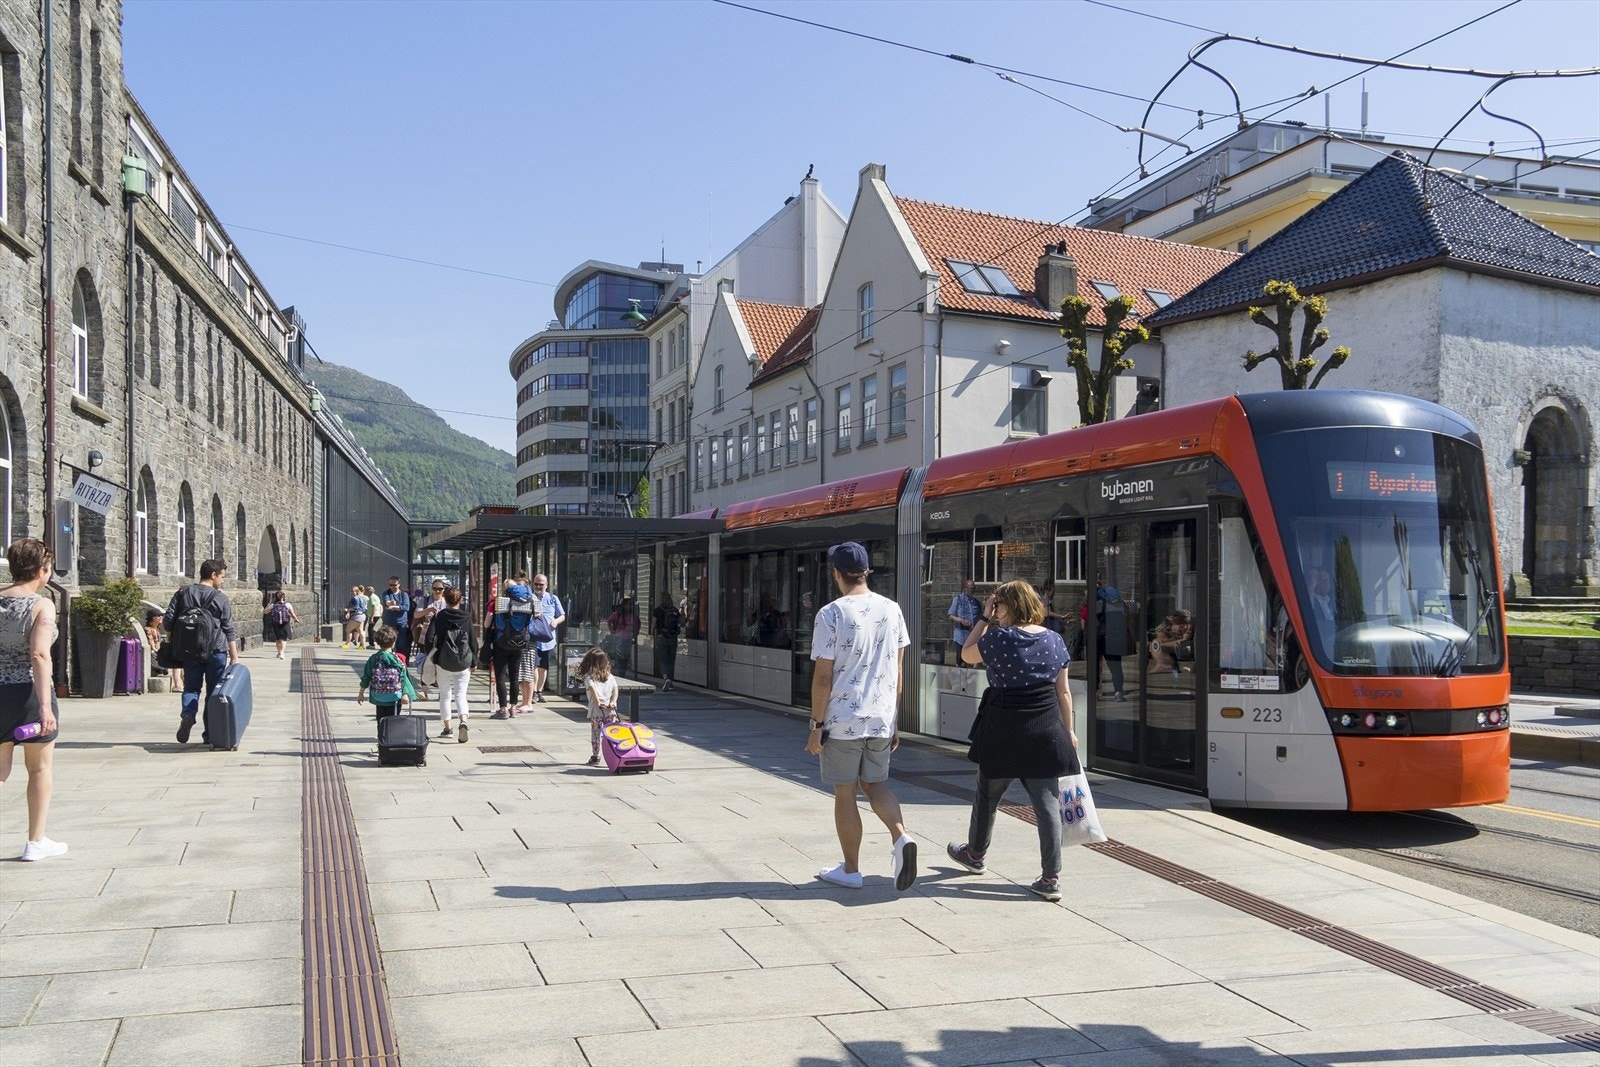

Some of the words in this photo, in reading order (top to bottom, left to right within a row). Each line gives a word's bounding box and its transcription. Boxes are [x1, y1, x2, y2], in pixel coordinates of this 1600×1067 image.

[1101, 479, 1154, 501] bybanen
[1336, 472, 1344, 492] 1
[75, 482, 112, 508] RITAZZA
[1252, 707, 1283, 723] 223
[1209, 742, 1217, 753] B
